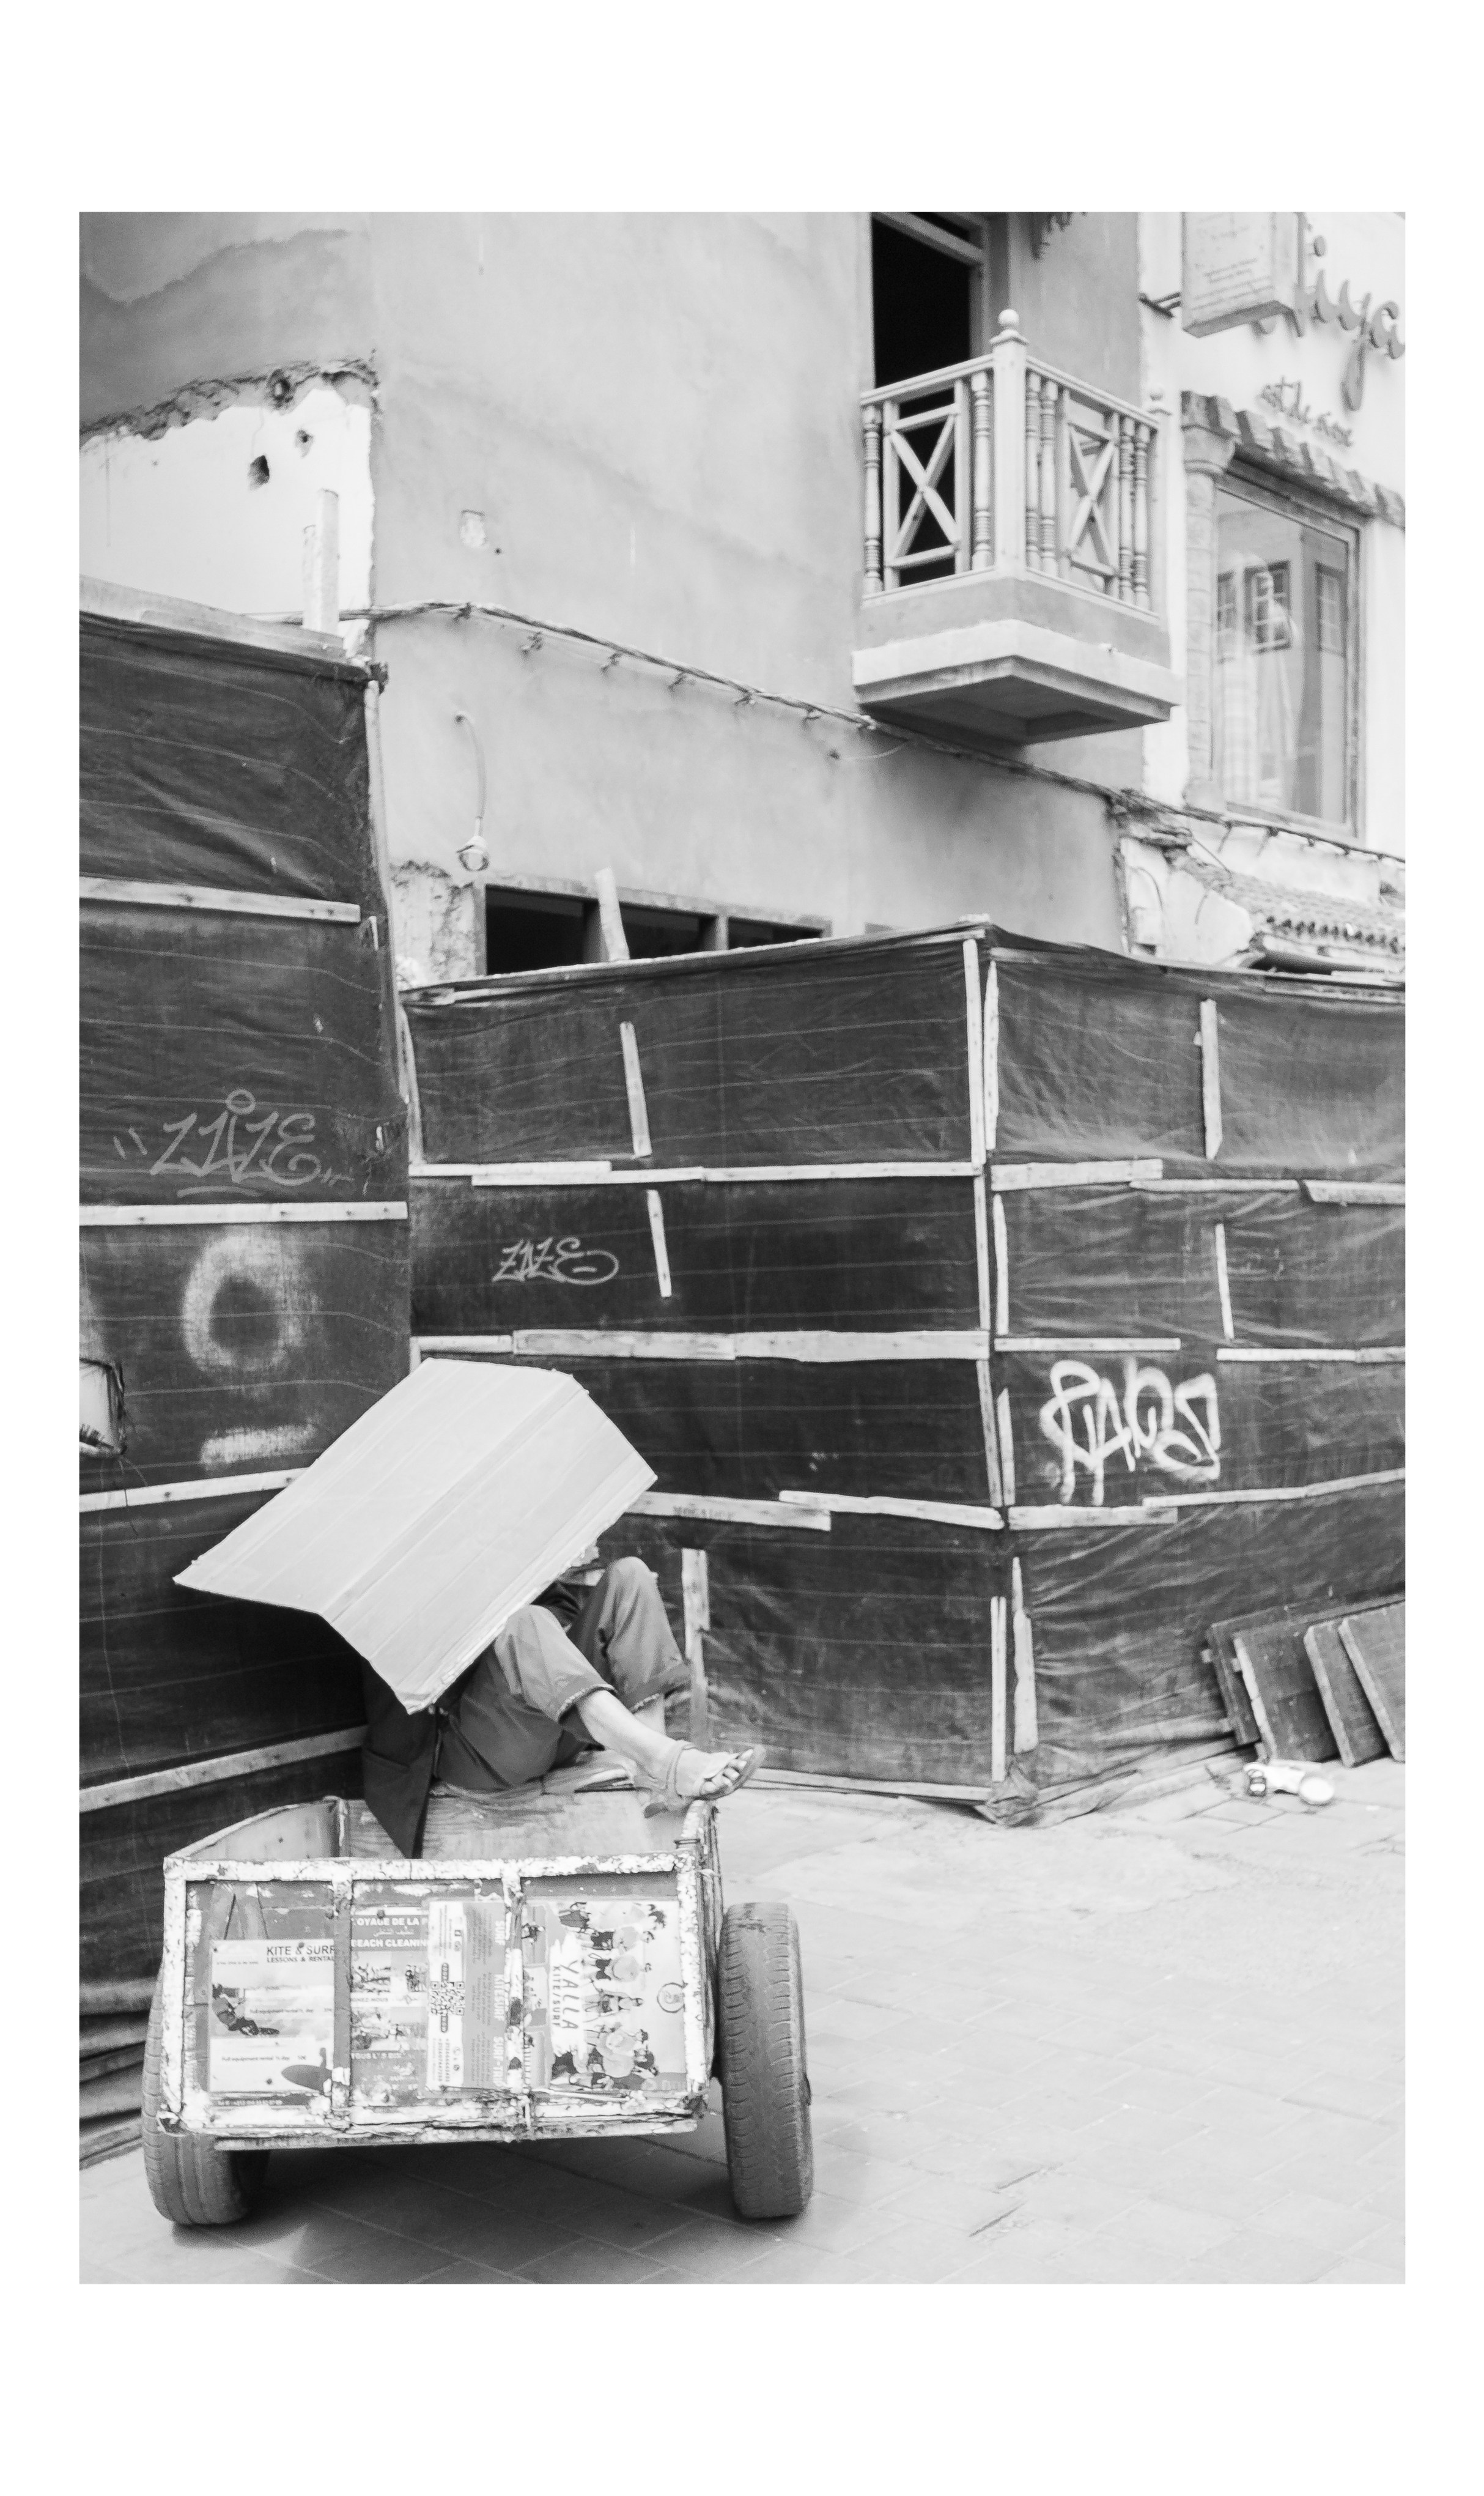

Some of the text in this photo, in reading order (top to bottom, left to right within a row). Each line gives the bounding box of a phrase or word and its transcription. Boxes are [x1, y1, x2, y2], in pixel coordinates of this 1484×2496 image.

[352, 1917, 389, 1926] OYAGE
[392, 1917, 404, 1926] DE
[407, 1917, 419, 1926] LA
[495, 1920, 505, 1946] SURF
[267, 1946, 291, 1955] KITE
[295, 1945, 302, 1955] &
[493, 1974, 505, 2021] KITESURF
[552, 1966, 561, 2028] KITE/SURF
[560, 1960, 580, 2030] YALLA
